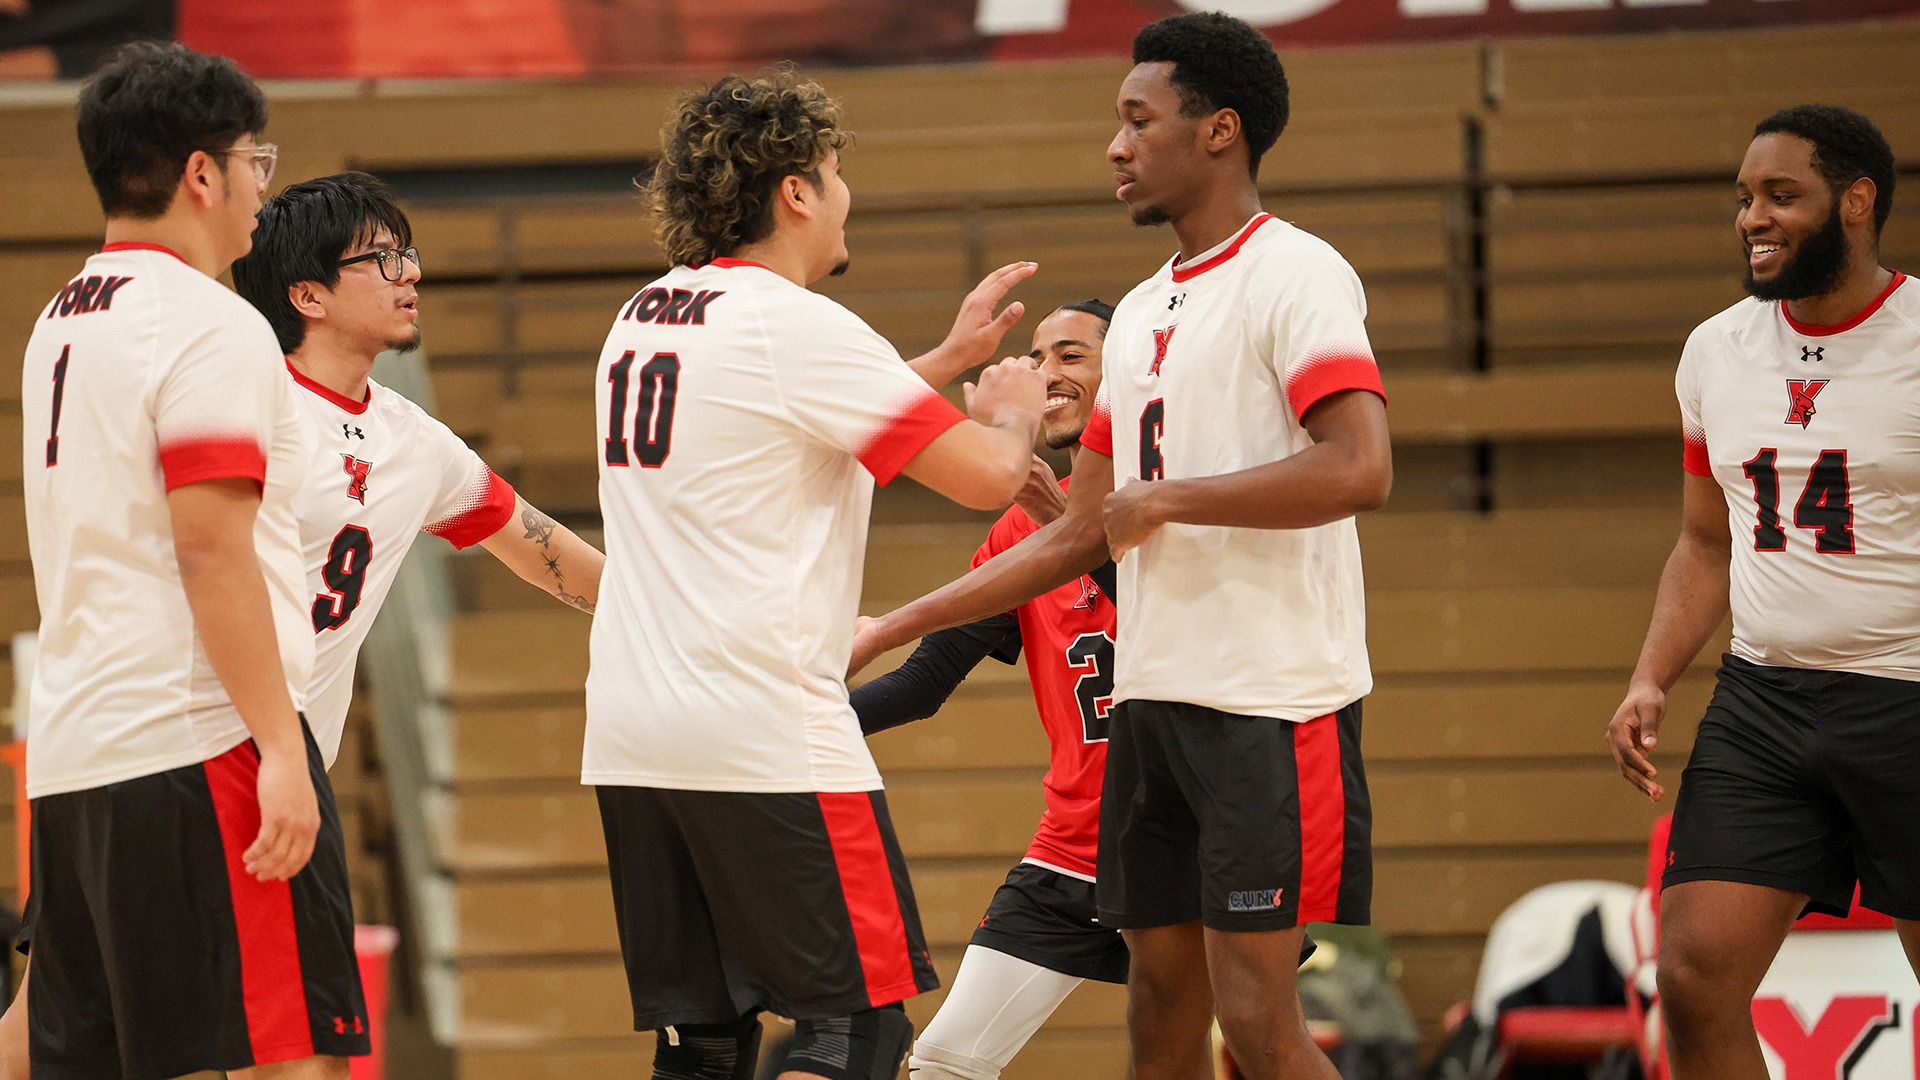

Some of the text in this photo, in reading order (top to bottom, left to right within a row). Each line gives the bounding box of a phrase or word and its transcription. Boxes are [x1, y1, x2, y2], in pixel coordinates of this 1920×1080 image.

[46, 275, 134, 319] YORK
[622, 287, 727, 325] YORK
[46, 344, 71, 468] 1
[605, 350, 681, 468] 10
[1139, 397, 1165, 481] 6
[1742, 447, 1856, 554] 14
[311, 523, 374, 634] 9
[1066, 630, 1116, 744] 2
[1228, 888, 1284, 909] CUNY
[1751, 994, 1920, 1080] Y
